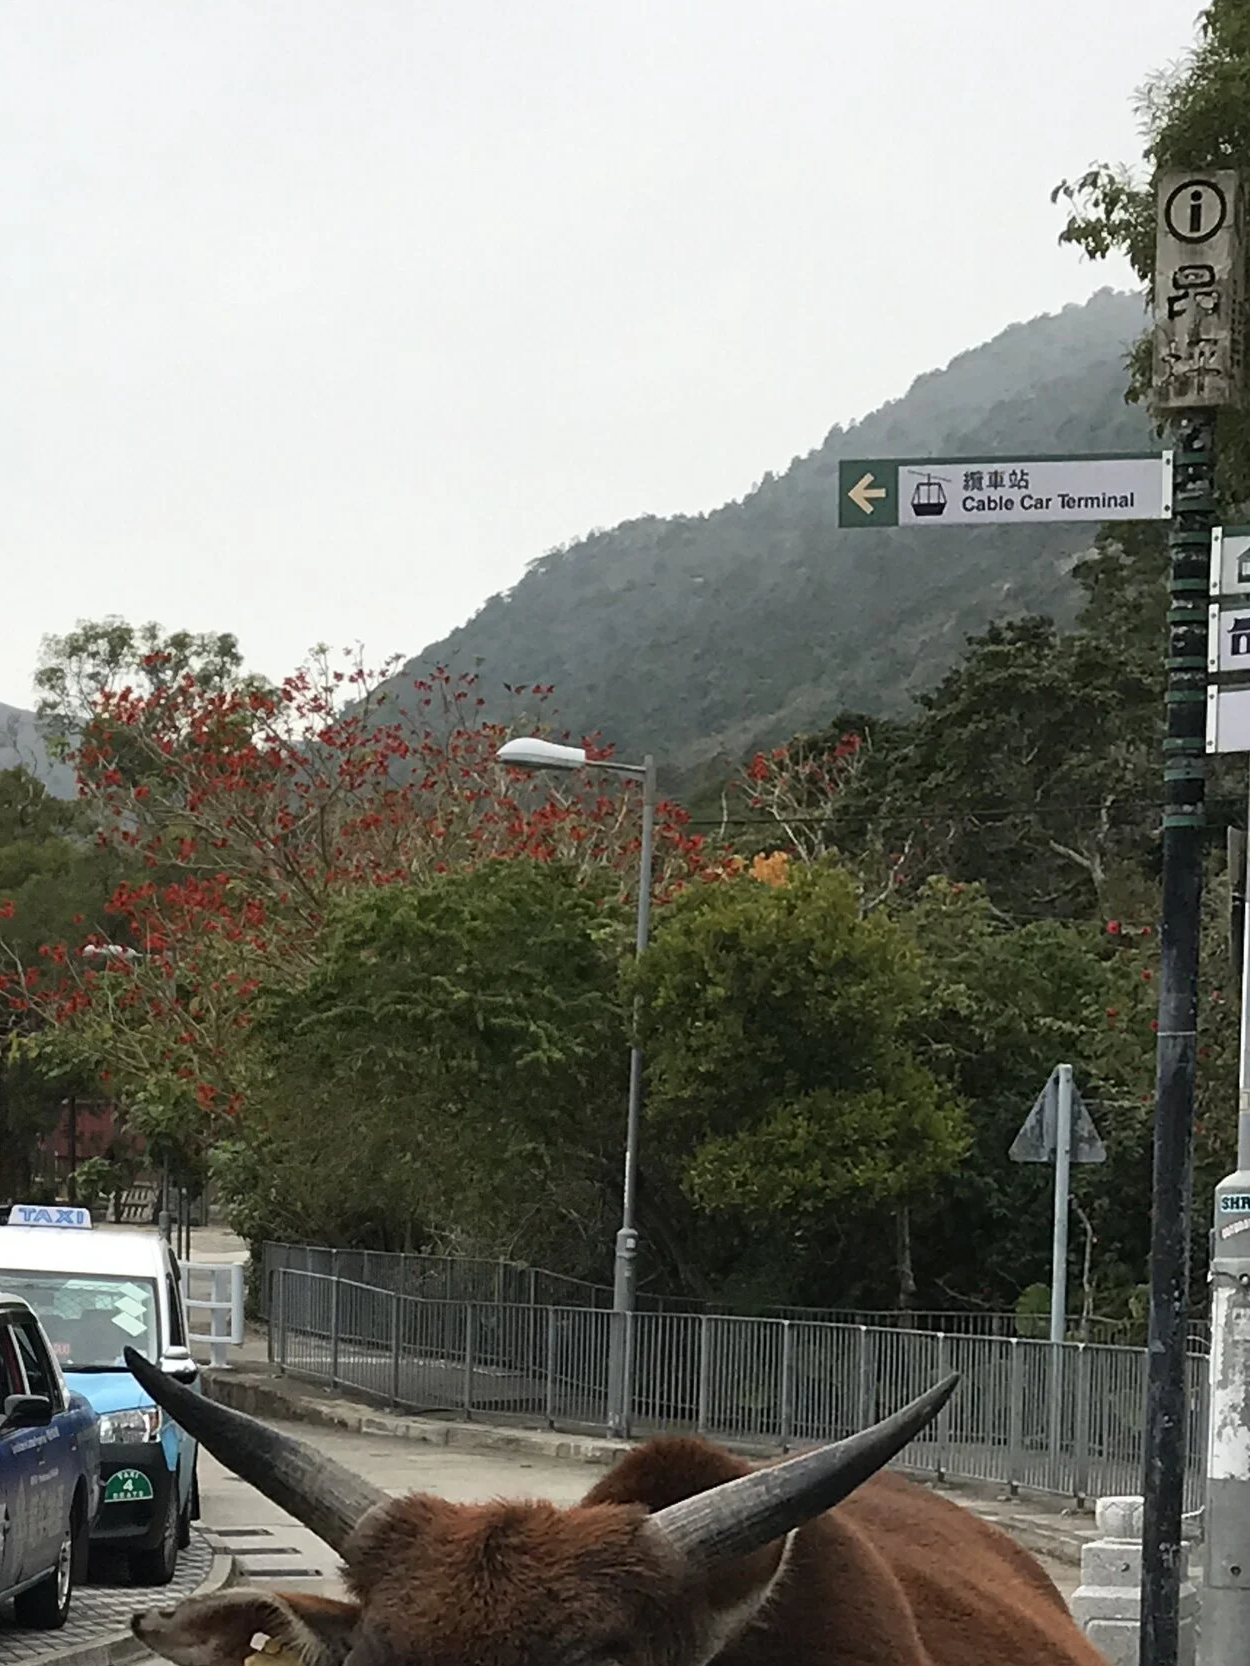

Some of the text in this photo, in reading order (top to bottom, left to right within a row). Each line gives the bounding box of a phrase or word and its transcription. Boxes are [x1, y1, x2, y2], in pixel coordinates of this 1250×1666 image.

[962, 492, 1134, 512] Cable Car Terminal
[18, 1207, 84, 1224] TAXI
[123, 1479, 133, 1491] 4
